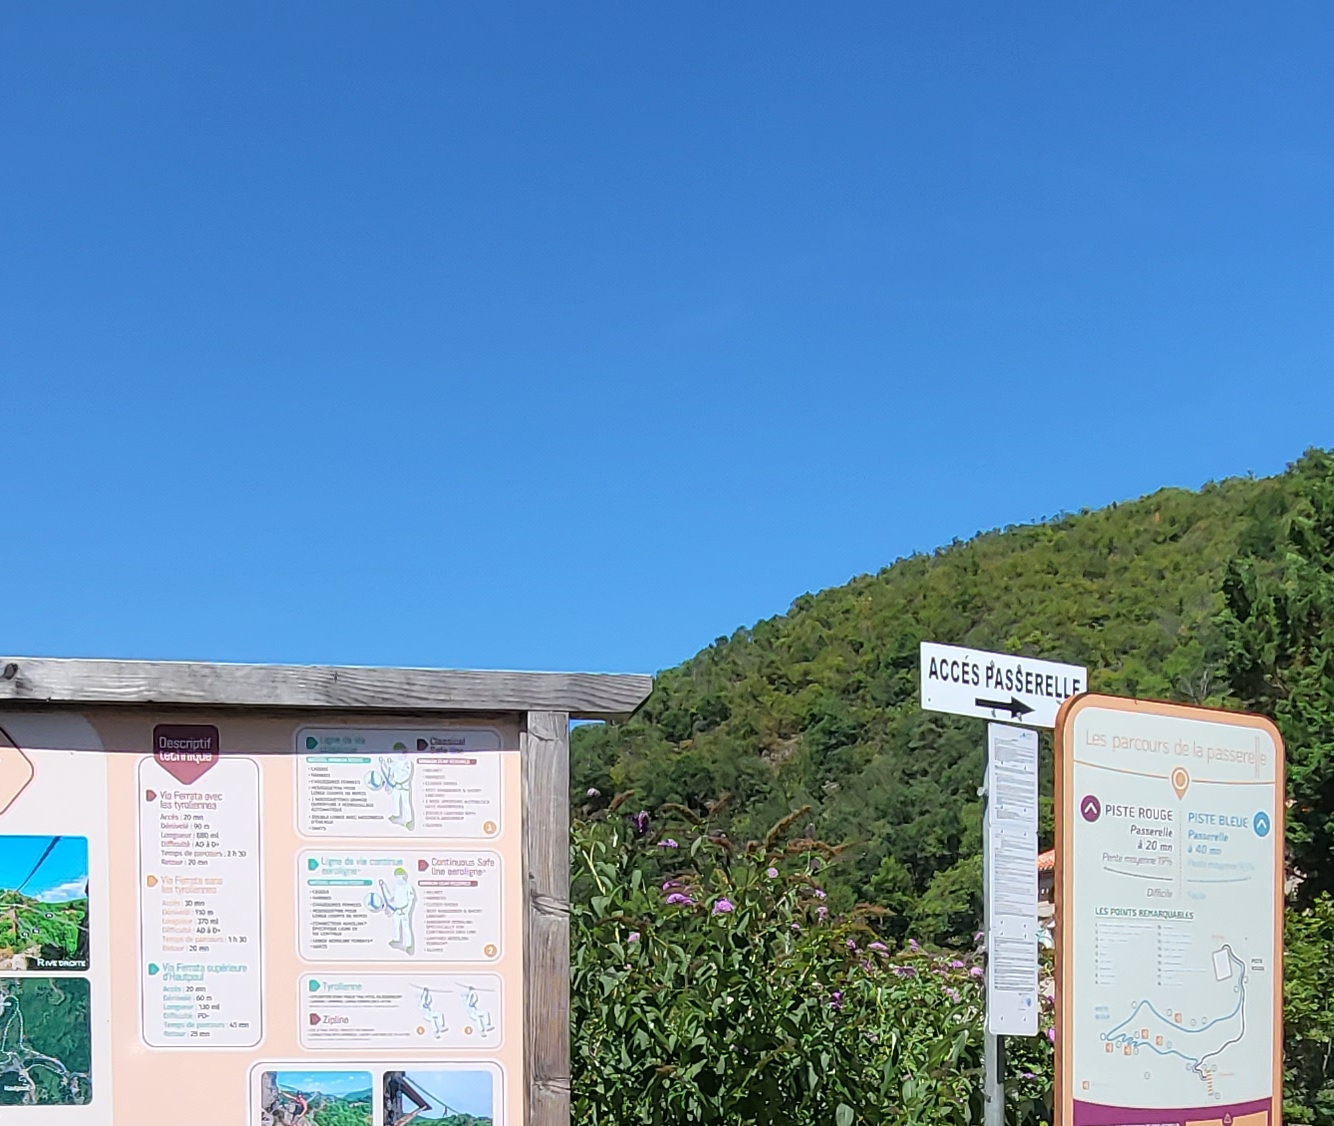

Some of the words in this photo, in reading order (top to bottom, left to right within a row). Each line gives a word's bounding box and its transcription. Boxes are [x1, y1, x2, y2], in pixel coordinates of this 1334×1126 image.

[986, 666, 1080, 699] PASSERELLE
[159, 736, 212, 750] Descriptif
[1086, 730, 1107, 746] Les
[1113, 734, 1169, 755] parcours
[1174, 739, 1189, 756] de
[1193, 740, 1204, 757] la
[159, 751, 212, 764] technique
[1105, 804, 1135, 818] PISTE
[1138, 807, 1173, 821] ROUGE
[1188, 812, 1216, 825] PISTE
[1219, 815, 1248, 828] BLEUE
[1130, 825, 1173, 838] Passerelle
[1145, 840, 1157, 851] 20
[1095, 907, 1108, 916] LES
[1110, 908, 1137, 917] POINTS
